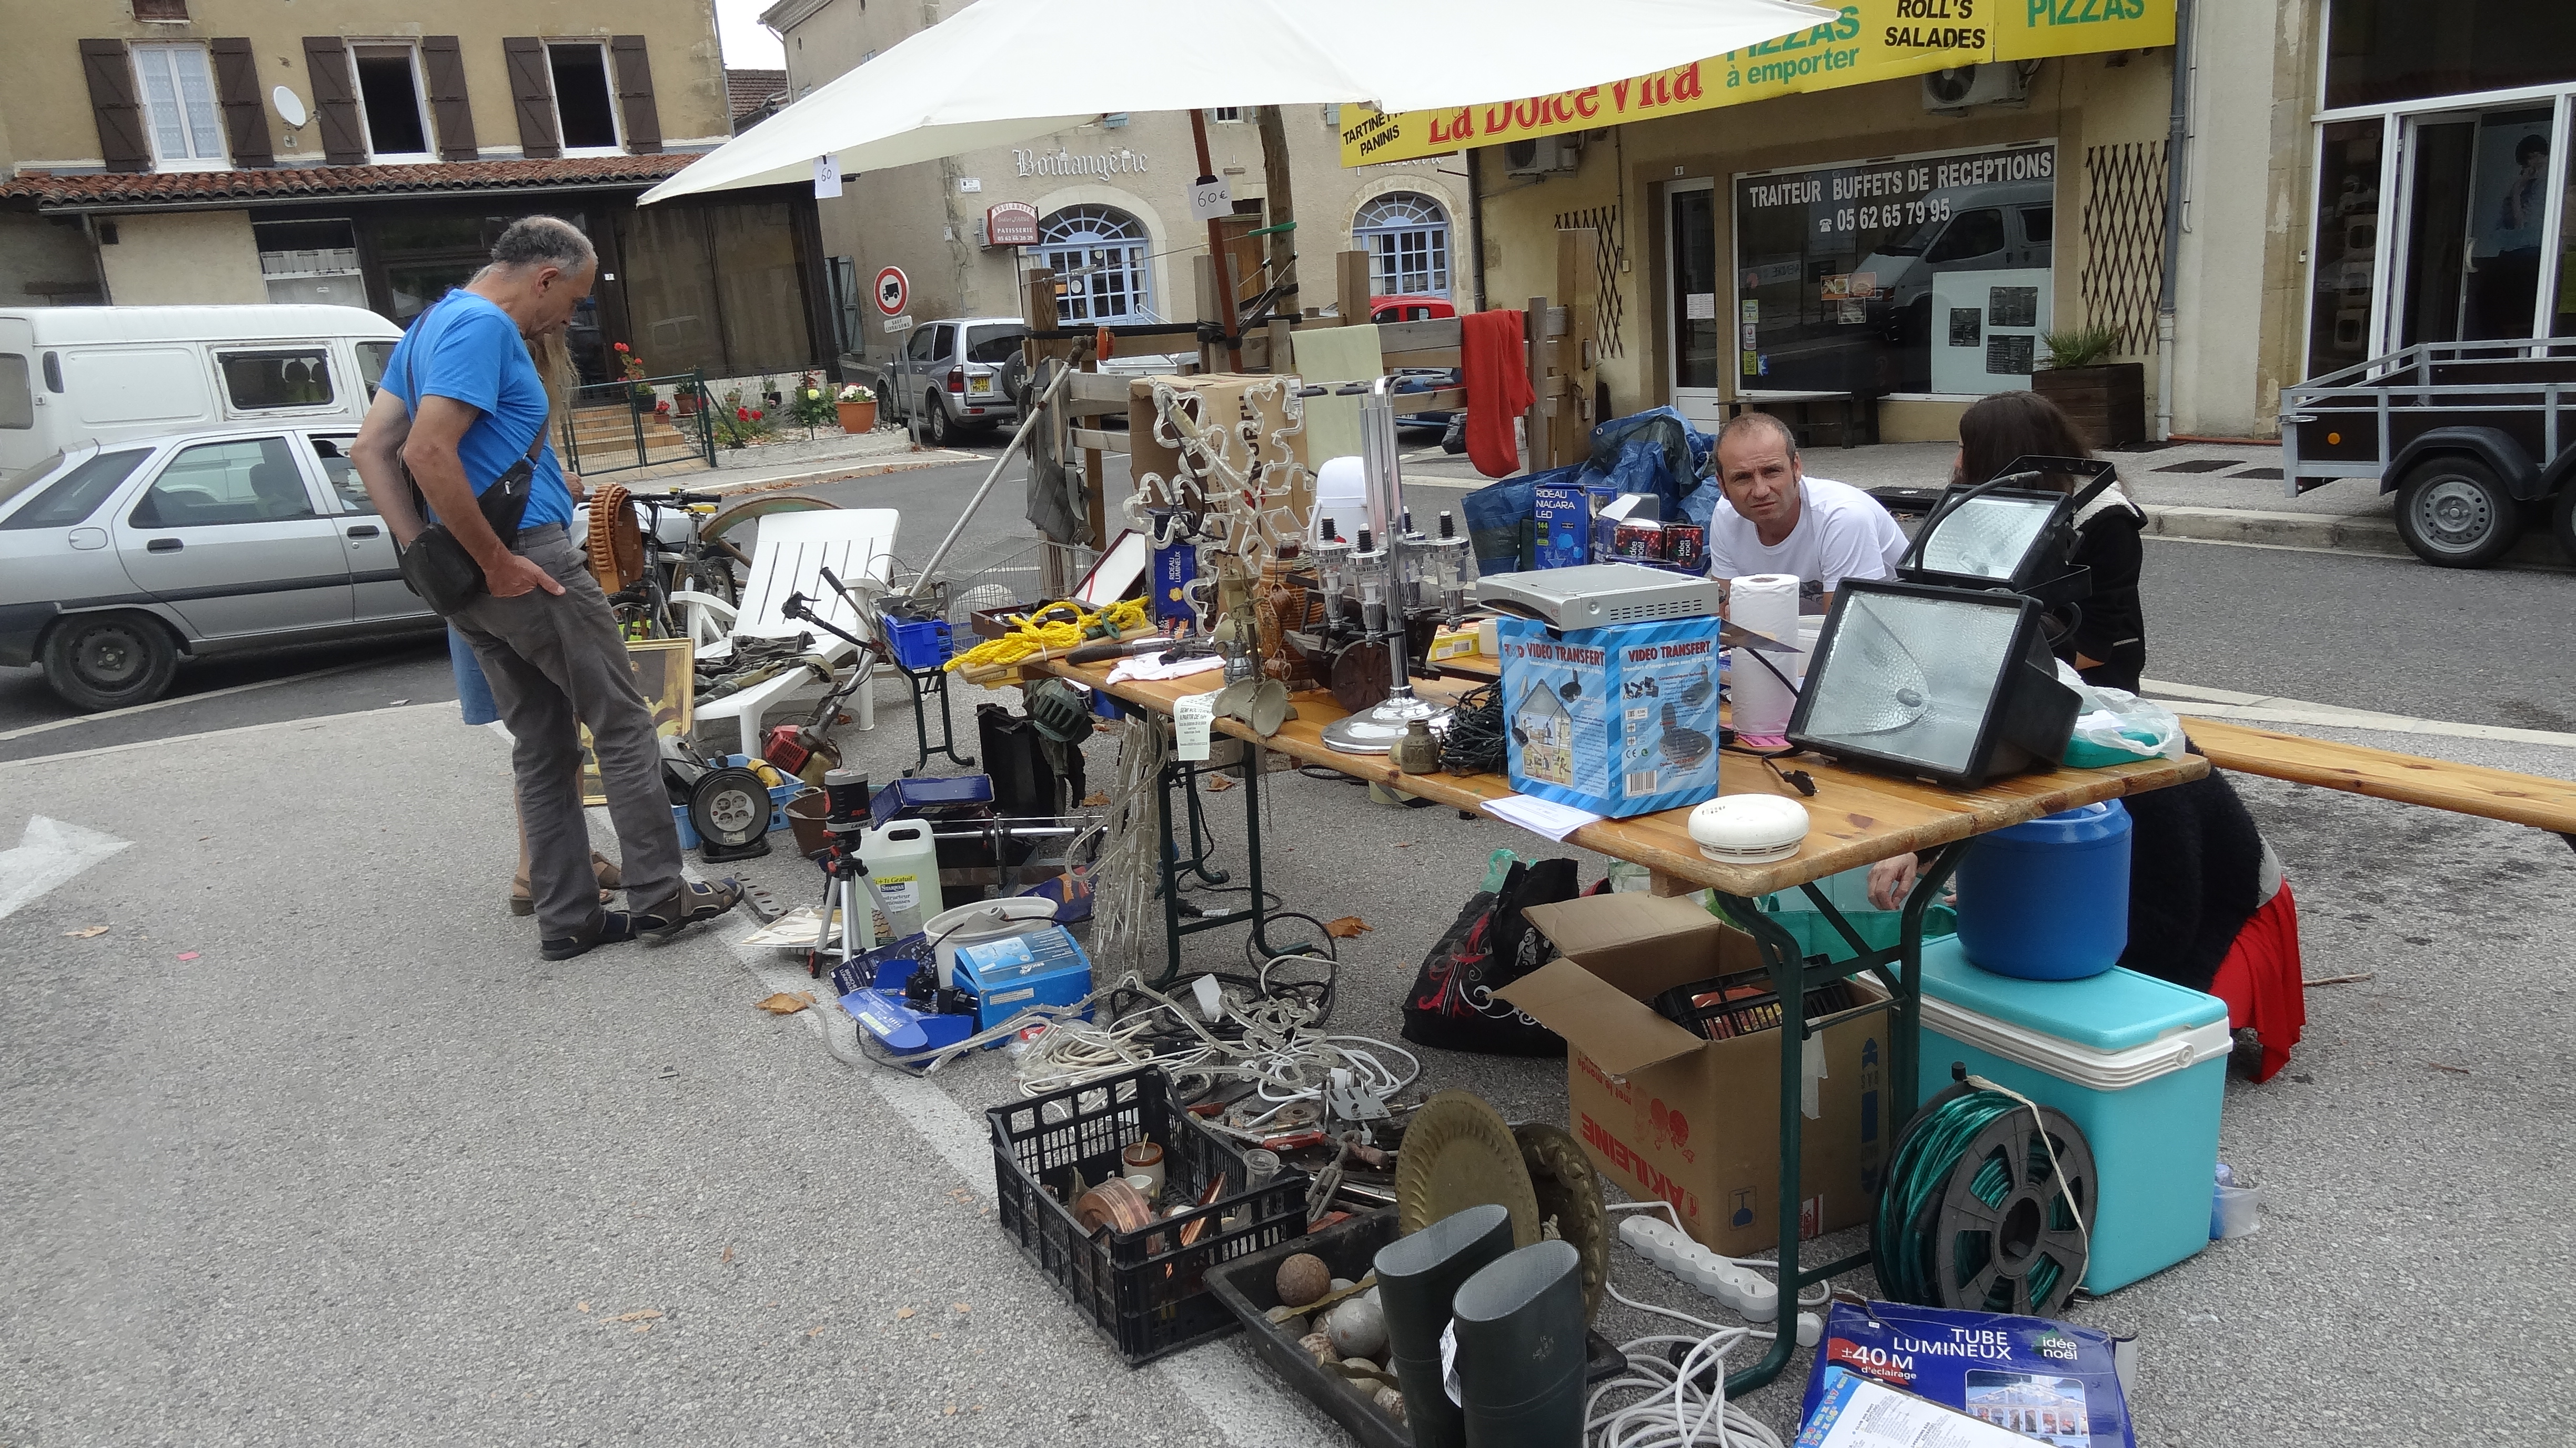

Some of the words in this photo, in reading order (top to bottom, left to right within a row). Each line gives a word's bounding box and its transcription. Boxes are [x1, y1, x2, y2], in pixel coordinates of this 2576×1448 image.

[1897, 0, 1973, 19] ROLL'S
[2027, 0, 2145, 28] PIZZAS
[1885, 26, 1986, 49] SALADES
[1726, 64, 1740, 88] à
[1747, 46, 1860, 85] emporter
[1428, 105, 1475, 145] La
[1360, 124, 1400, 156] PANINIS
[1012, 146, 1149, 182] Boulangerie
[821, 167, 832, 182] 60
[1749, 179, 1821, 208] TRAITEUR
[1833, 170, 1902, 202] BUFFETS
[1908, 166, 1929, 192] DE
[1937, 152, 2051, 188] RECEPTIONS
[1198, 190, 1228, 207] 60€
[994, 203, 1033, 214] BOULANGER
[1837, 208, 1855, 232] 05
[1859, 205, 1877, 229] 62
[1882, 203, 1900, 227] 65
[1905, 200, 1925, 225] 79
[1930, 198, 1950, 223] 95
[1536, 489, 1567, 498] RIDEAU
[1536, 500, 1575, 509] NIAGARA
[1536, 510, 1553, 519] LED
[1526, 642, 1553, 660] VIDEO
[1555, 645, 1605, 667] TRANSFERT
[1628, 647, 1658, 662] VIDEO
[1660, 640, 1710, 659] TRANSFERT
[1581, 1111, 1685, 1211] AKILEINE
[1951, 1329, 2008, 1346] TUBE
[2042, 1336, 2077, 1350] idée
[1894, 1337, 2013, 1361] LUMINEUX
[2043, 1349, 2078, 1360] noël
[1892, 1354, 1913, 1370] M
[1861, 1366, 1917, 1380] d'éclairage
[1824, 1389, 1839, 1404] 117
